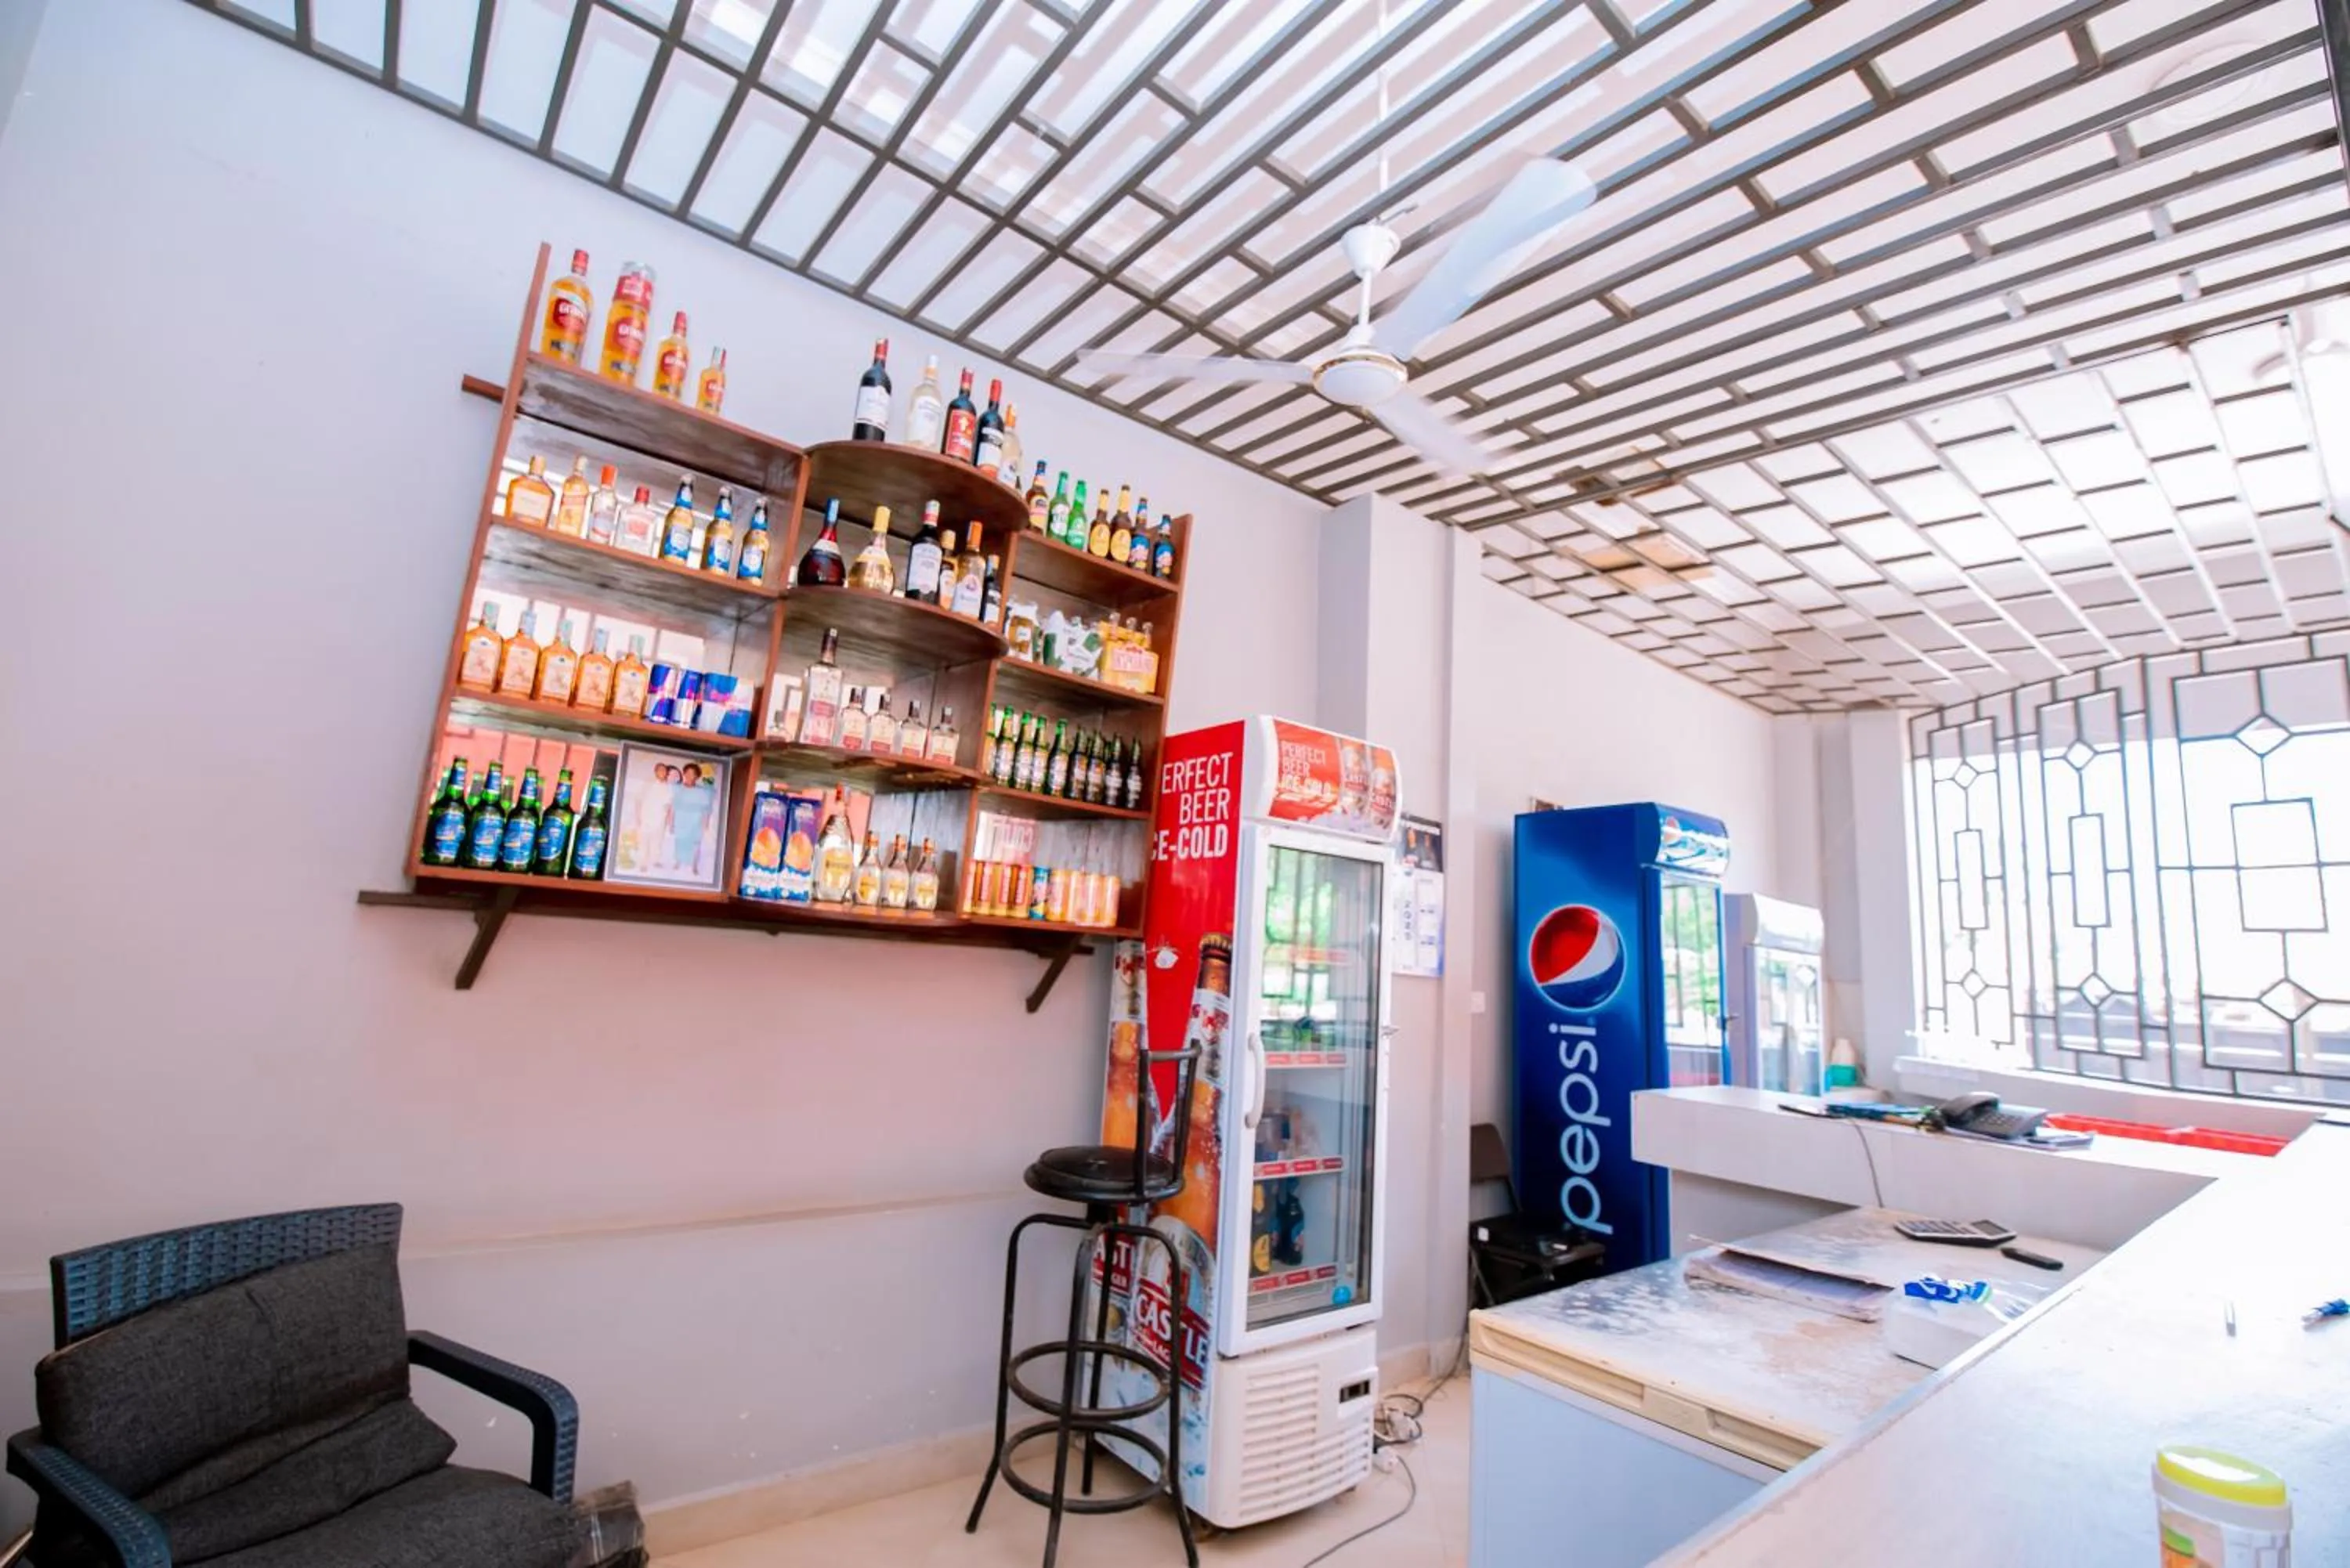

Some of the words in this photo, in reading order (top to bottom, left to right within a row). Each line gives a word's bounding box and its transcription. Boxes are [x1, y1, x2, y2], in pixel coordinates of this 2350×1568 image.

[1281, 740, 1326, 764] PERFECT
[1282, 758, 1311, 779] BEER
[1162, 752, 1234, 794] ERFECT
[1179, 787, 1231, 825] BEER
[1152, 823, 1229, 861] E-COLD
[1548, 1022, 1614, 1235] pepsi
[1136, 1293, 1209, 1370] CASLE
